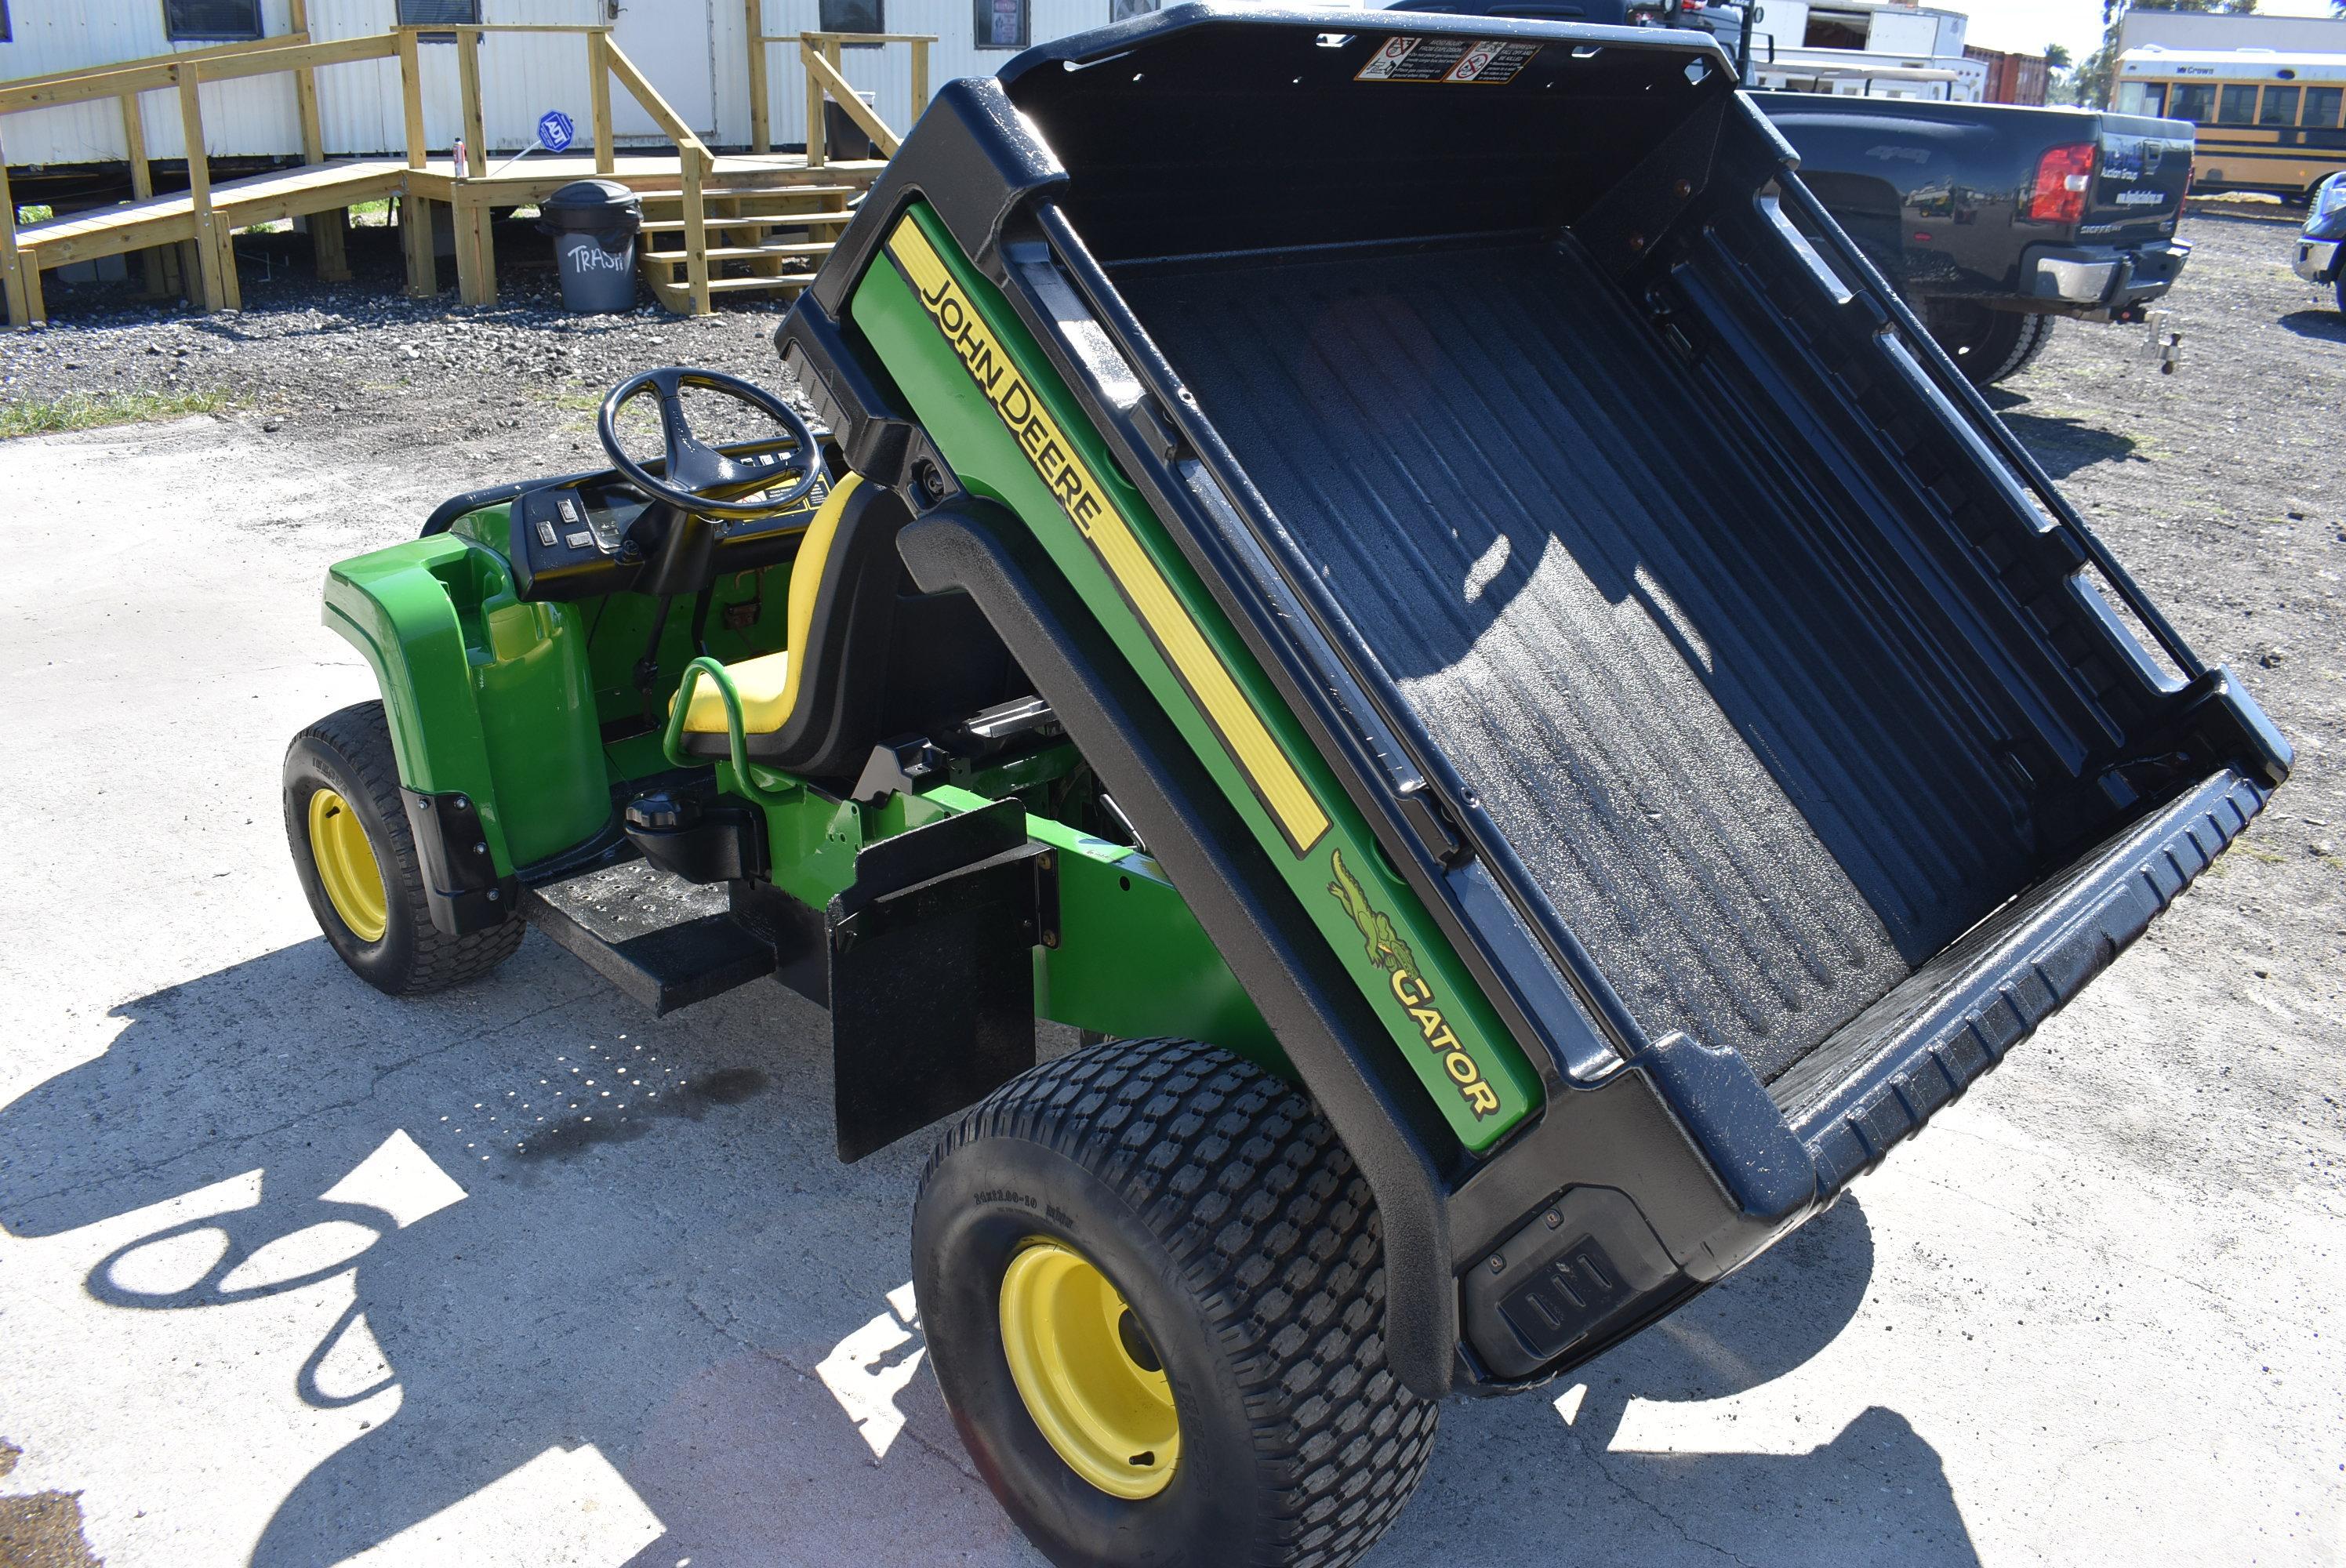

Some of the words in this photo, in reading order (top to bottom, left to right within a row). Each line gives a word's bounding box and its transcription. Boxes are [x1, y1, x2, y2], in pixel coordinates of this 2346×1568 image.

[545, 122, 567, 144] ADT
[568, 244, 624, 274] TRASH
[922, 279, 1005, 392] JOHN
[1000, 379, 1102, 531] DEERE
[1391, 970, 1499, 1116] GATOR
